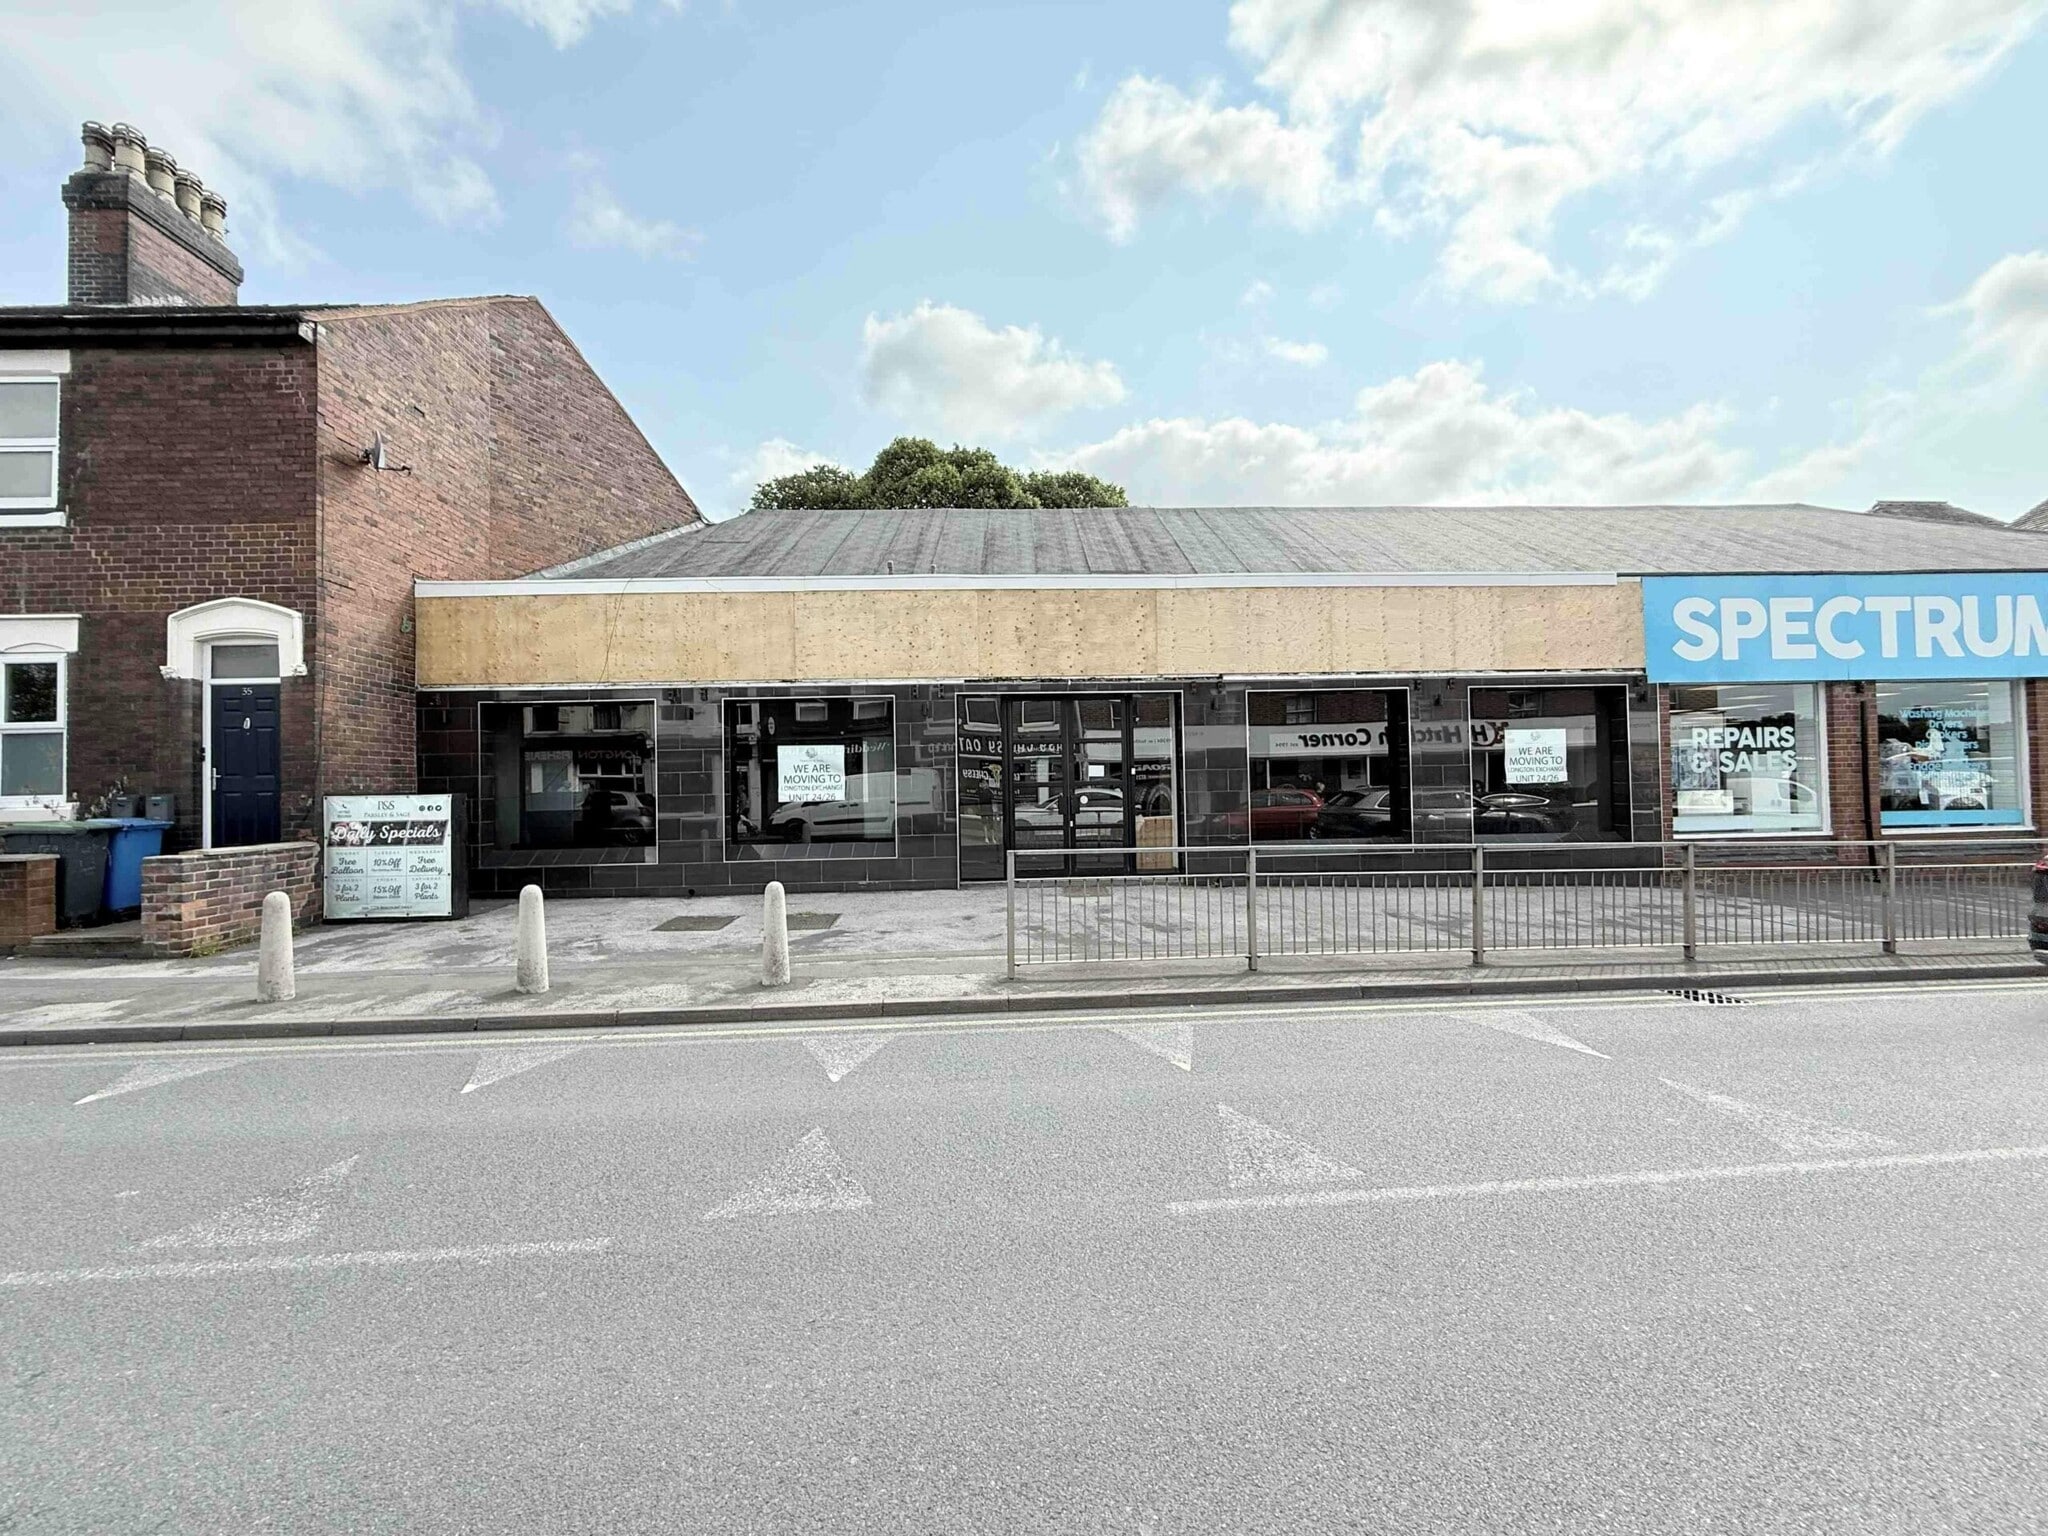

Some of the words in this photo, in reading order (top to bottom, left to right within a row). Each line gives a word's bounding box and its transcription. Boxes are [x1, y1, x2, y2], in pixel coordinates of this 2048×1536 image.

[1900, 709, 1942, 720] Washing
[1929, 720, 1963, 730] Dryers
[1692, 726, 1795, 749] REPAIRS
[1518, 747, 1534, 756] WE
[1535, 746, 1553, 755] ARE
[1509, 756, 1549, 766] MOVING
[1550, 756, 1563, 765] TO
[1690, 752, 1713, 773] &
[1719, 750, 1797, 773] SALES
[793, 764, 809, 773] WE
[811, 763, 831, 773] ARE
[783, 774, 826, 784] MOVING
[827, 773, 842, 784] TO
[788, 793, 810, 801] UNIT
[333, 823, 376, 844] Daily
[379, 824, 442, 844] Specials
[338, 857, 357, 866] Free
[417, 855, 436, 864] Free
[330, 866, 364, 875] Balloon
[408, 864, 443, 876] Delivery
[414, 882, 420, 890] 3
[420, 882, 432, 892] for
[432, 882, 439, 890] 2
[334, 893, 361, 902] Plants
[414, 892, 439, 900] Plants
